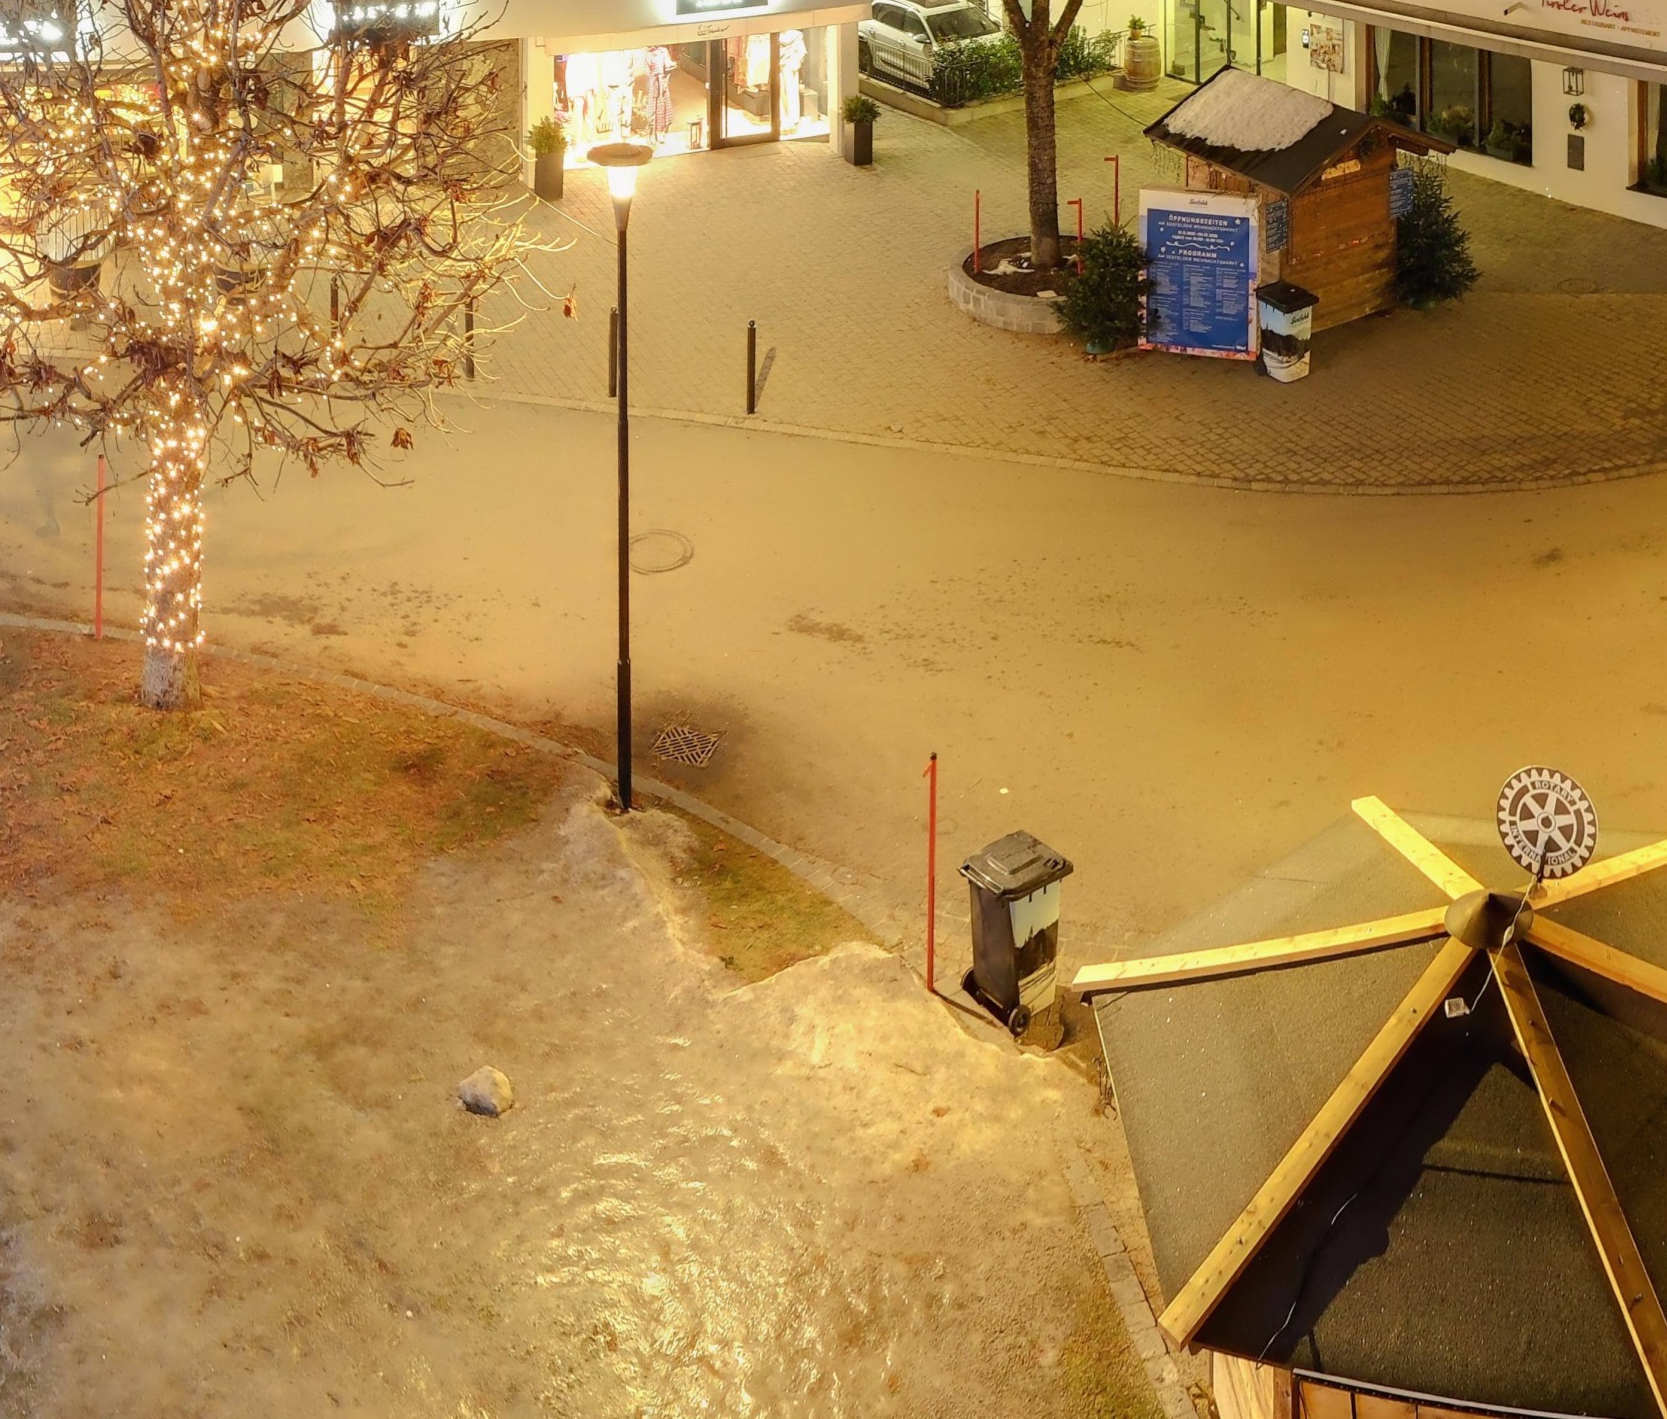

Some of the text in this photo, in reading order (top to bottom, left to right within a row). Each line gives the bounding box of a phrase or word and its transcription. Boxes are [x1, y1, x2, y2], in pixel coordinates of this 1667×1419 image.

[1168, 214, 1228, 227] ÖFFNUNGSZEITEN
[1178, 249, 1217, 259] PROGRAMM
[1534, 781, 1575, 802] ROTARY
[1510, 825, 1575, 866] INTERNAIONAL
